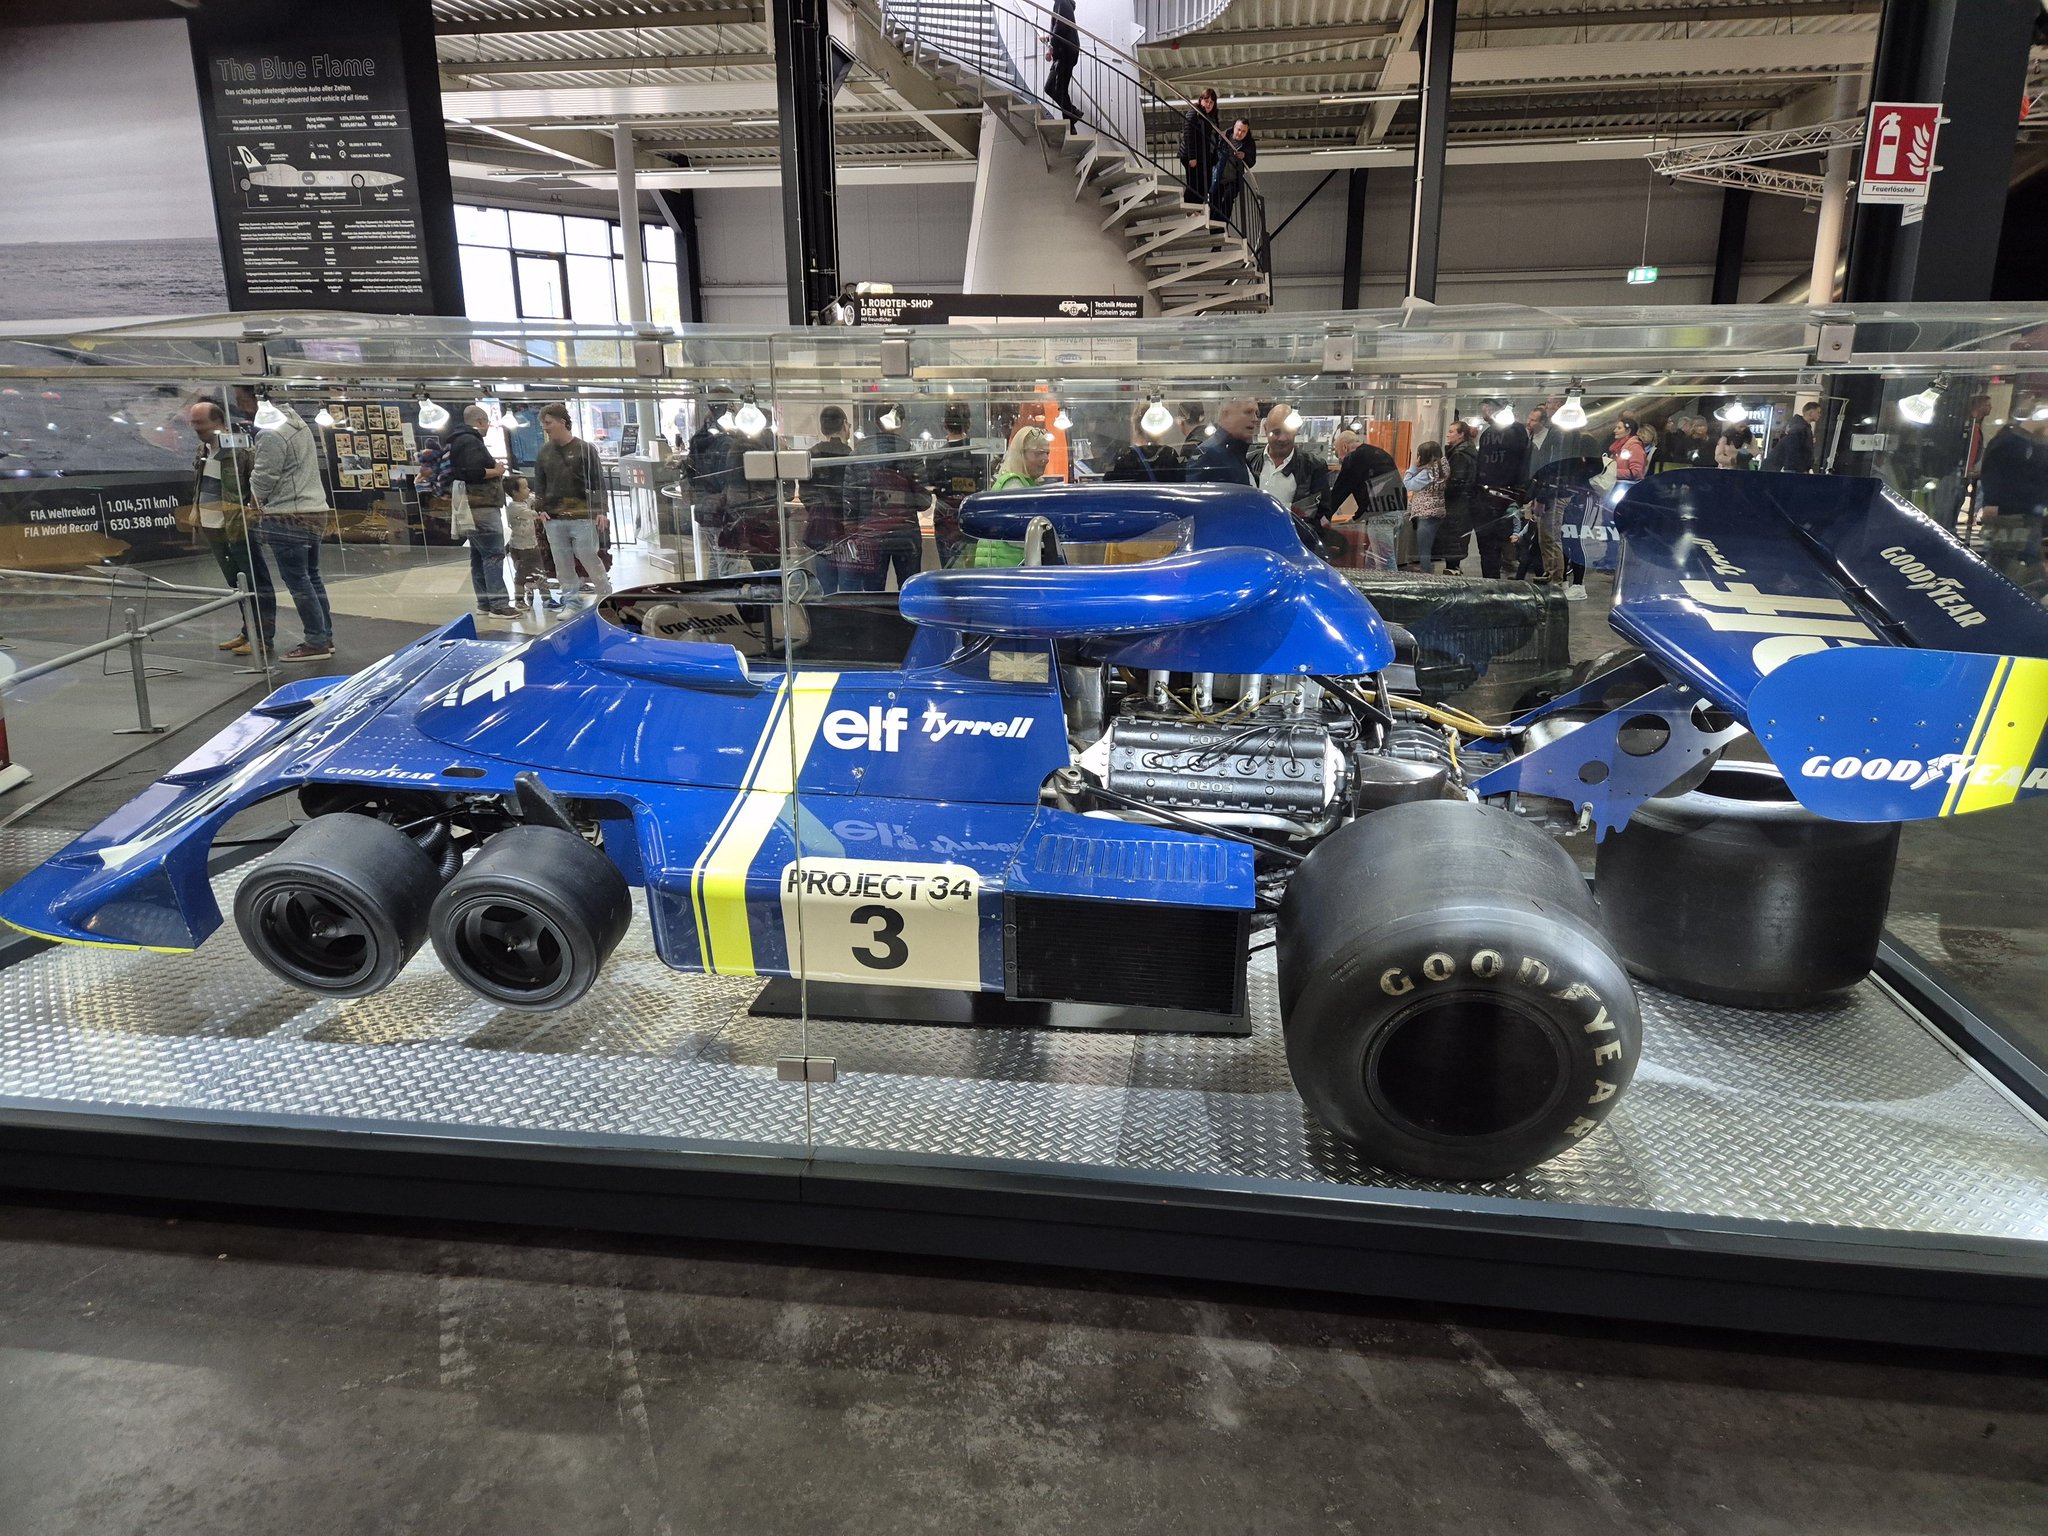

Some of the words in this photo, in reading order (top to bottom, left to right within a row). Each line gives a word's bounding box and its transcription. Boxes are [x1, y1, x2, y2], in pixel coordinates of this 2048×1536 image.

[216, 57, 256, 81] The
[261, 55, 307, 80] Blue
[311, 53, 375, 78] Flame
[236, 87, 261, 95] schnellste
[321, 84, 333, 92] aller
[252, 96, 269, 105] fastest
[269, 96, 310, 104] rocket-powered
[322, 94, 340, 102] vehicle
[340, 93, 347, 102] of
[354, 93, 369, 101] times
[1871, 185, 1916, 193] Feuerlöscher
[860, 298, 867, 307] 1.
[868, 298, 934, 308] ROBOTER-SHOP
[860, 308, 878, 317] DER
[879, 308, 902, 317] WELT
[30, 510, 47, 521] FIA
[47, 505, 97, 520] Weltrekord
[106, 498, 152, 513] 1.014,511
[153, 495, 179, 509] km/h
[24, 526, 40, 538] FIA
[41, 523, 68, 536] World
[68, 520, 99, 533] Record
[109, 515, 152, 531] 630.388
[154, 513, 176, 529] mph
[1880, 546, 1987, 628] GOODYEAR
[822, 706, 909, 752] elf
[921, 711, 1035, 742] Tyrrell
[324, 764, 436, 781] GOODYEAR
[1801, 754, 2048, 790] GOODYEAR
[1187, 780, 1234, 793] FORD
[787, 869, 925, 901] PROJECT
[928, 876, 972, 900] 34
[850, 904, 909, 970] 3
[1380, 949, 1622, 1138] GOODYEAR
